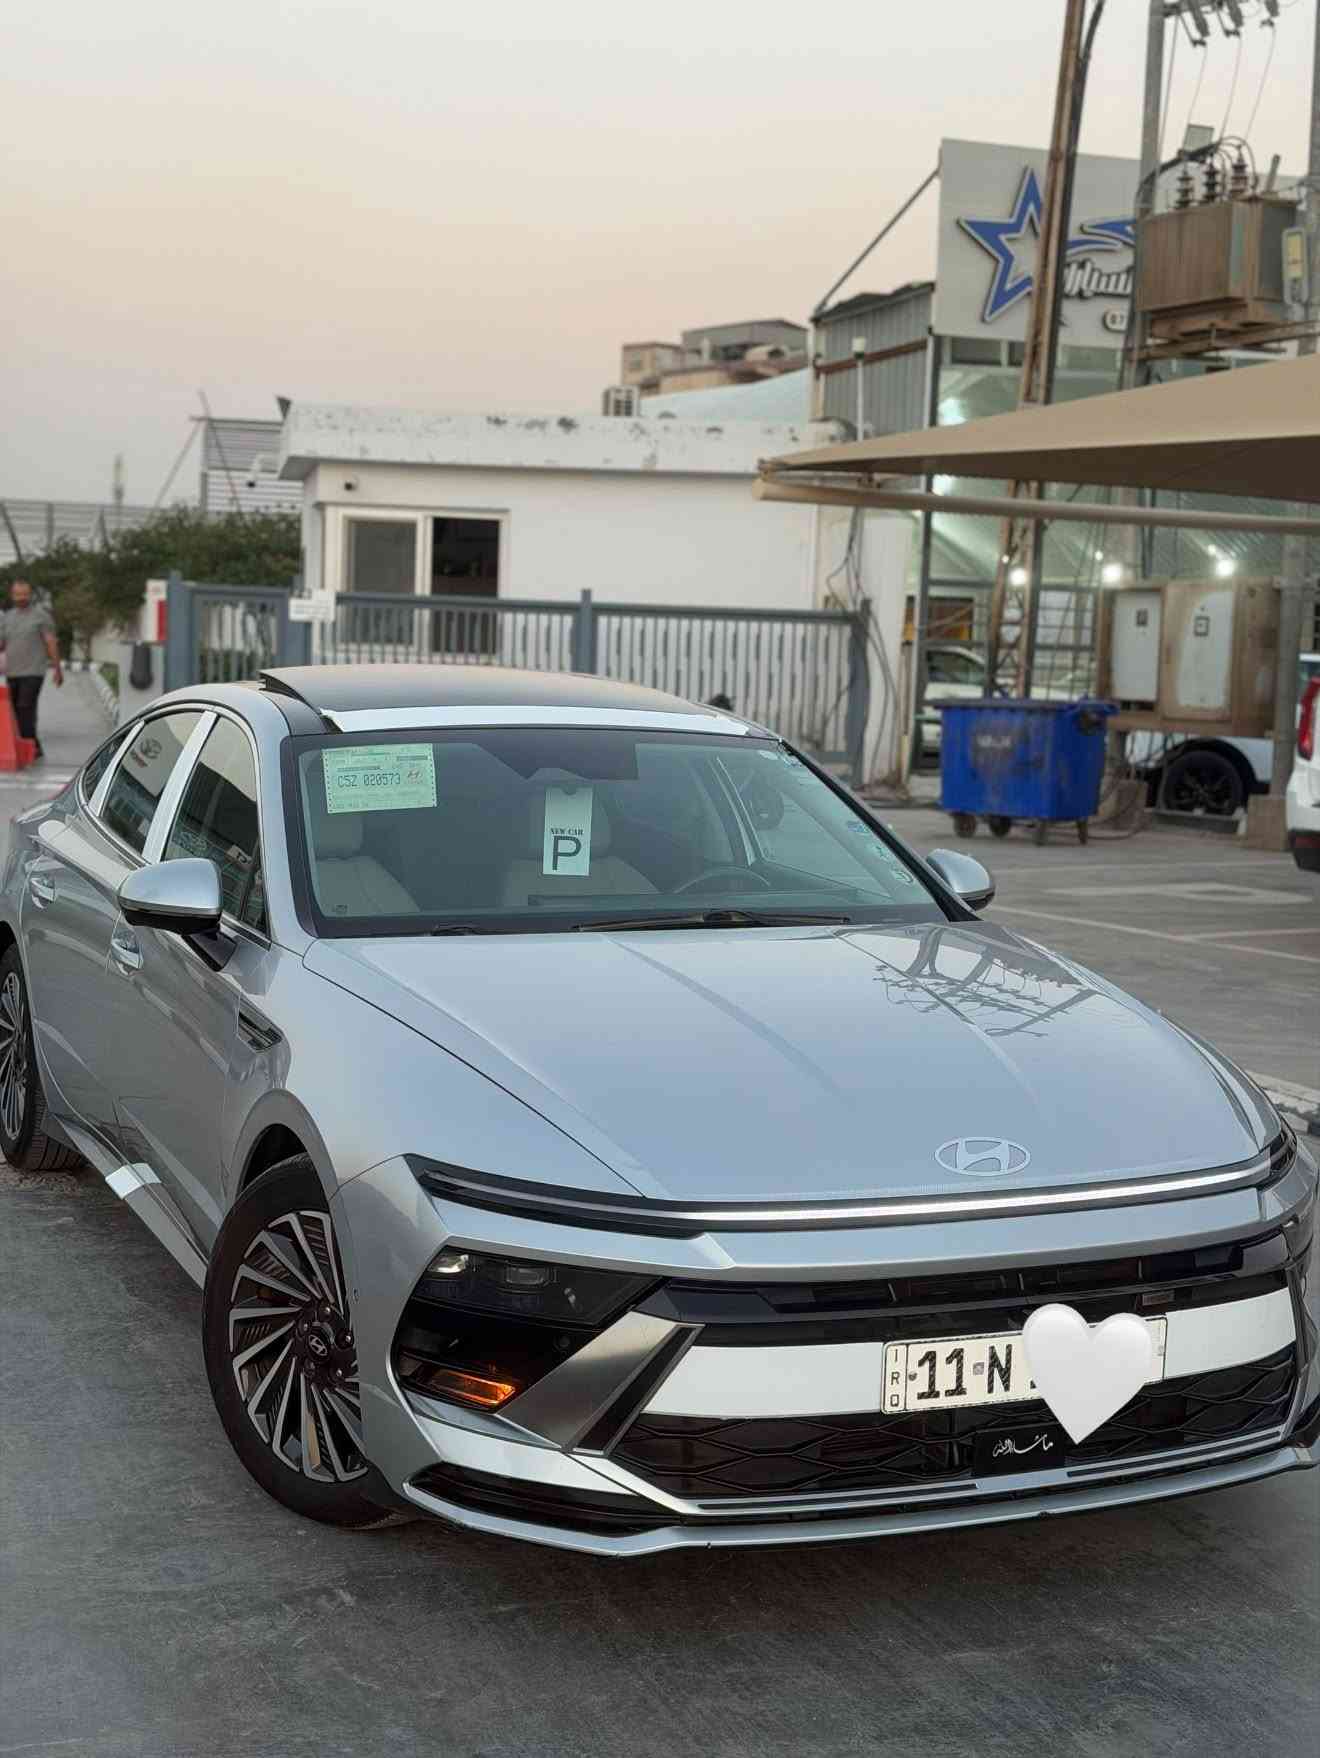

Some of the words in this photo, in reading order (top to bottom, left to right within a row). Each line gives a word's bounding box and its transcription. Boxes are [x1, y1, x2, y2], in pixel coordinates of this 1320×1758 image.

[568, 828, 584, 836] CAR
[551, 835, 582, 871] P
[916, 1347, 968, 1401] 11
[986, 1343, 1013, 1394] N
